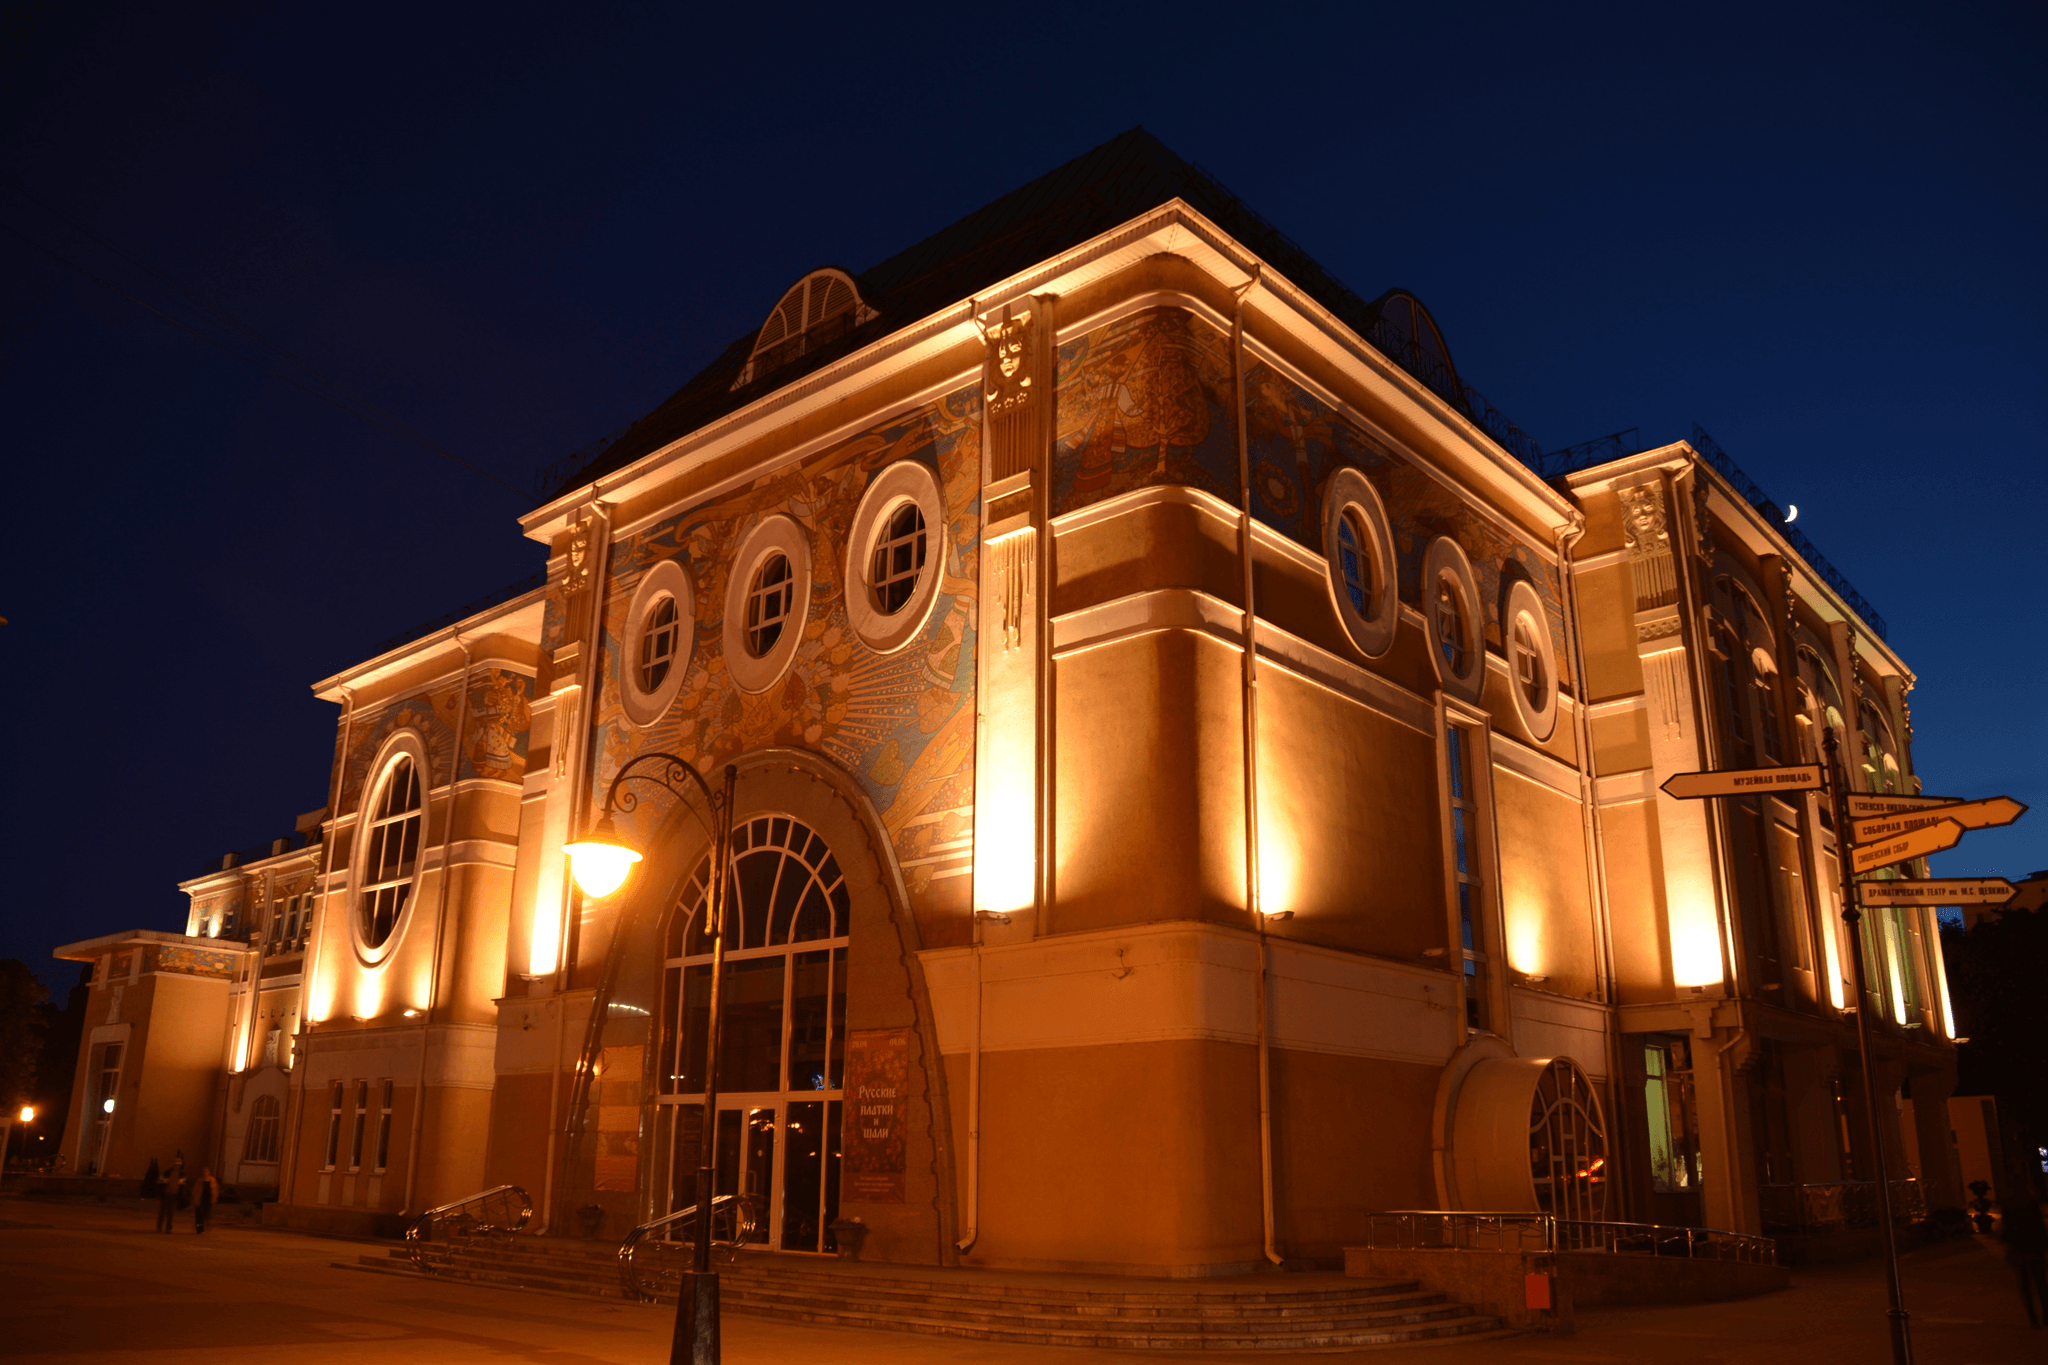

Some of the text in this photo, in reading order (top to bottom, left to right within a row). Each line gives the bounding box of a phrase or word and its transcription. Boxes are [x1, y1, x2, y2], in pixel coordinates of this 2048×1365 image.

[1734, 773, 1811, 787] МУЗЕЙНАЯ ПЛОЩАДЬ
[1863, 822, 1901, 835] СОБОРНАЯ
[1858, 841, 1909, 864] СМОЛЕНСКИЙ СОБОР
[1868, 887, 1924, 898] ДРАМАТИЧЕСКИЙ
[1927, 888, 1946, 896] ТЕАТР
[1978, 886, 2009, 896] ЩЕПКИНА
